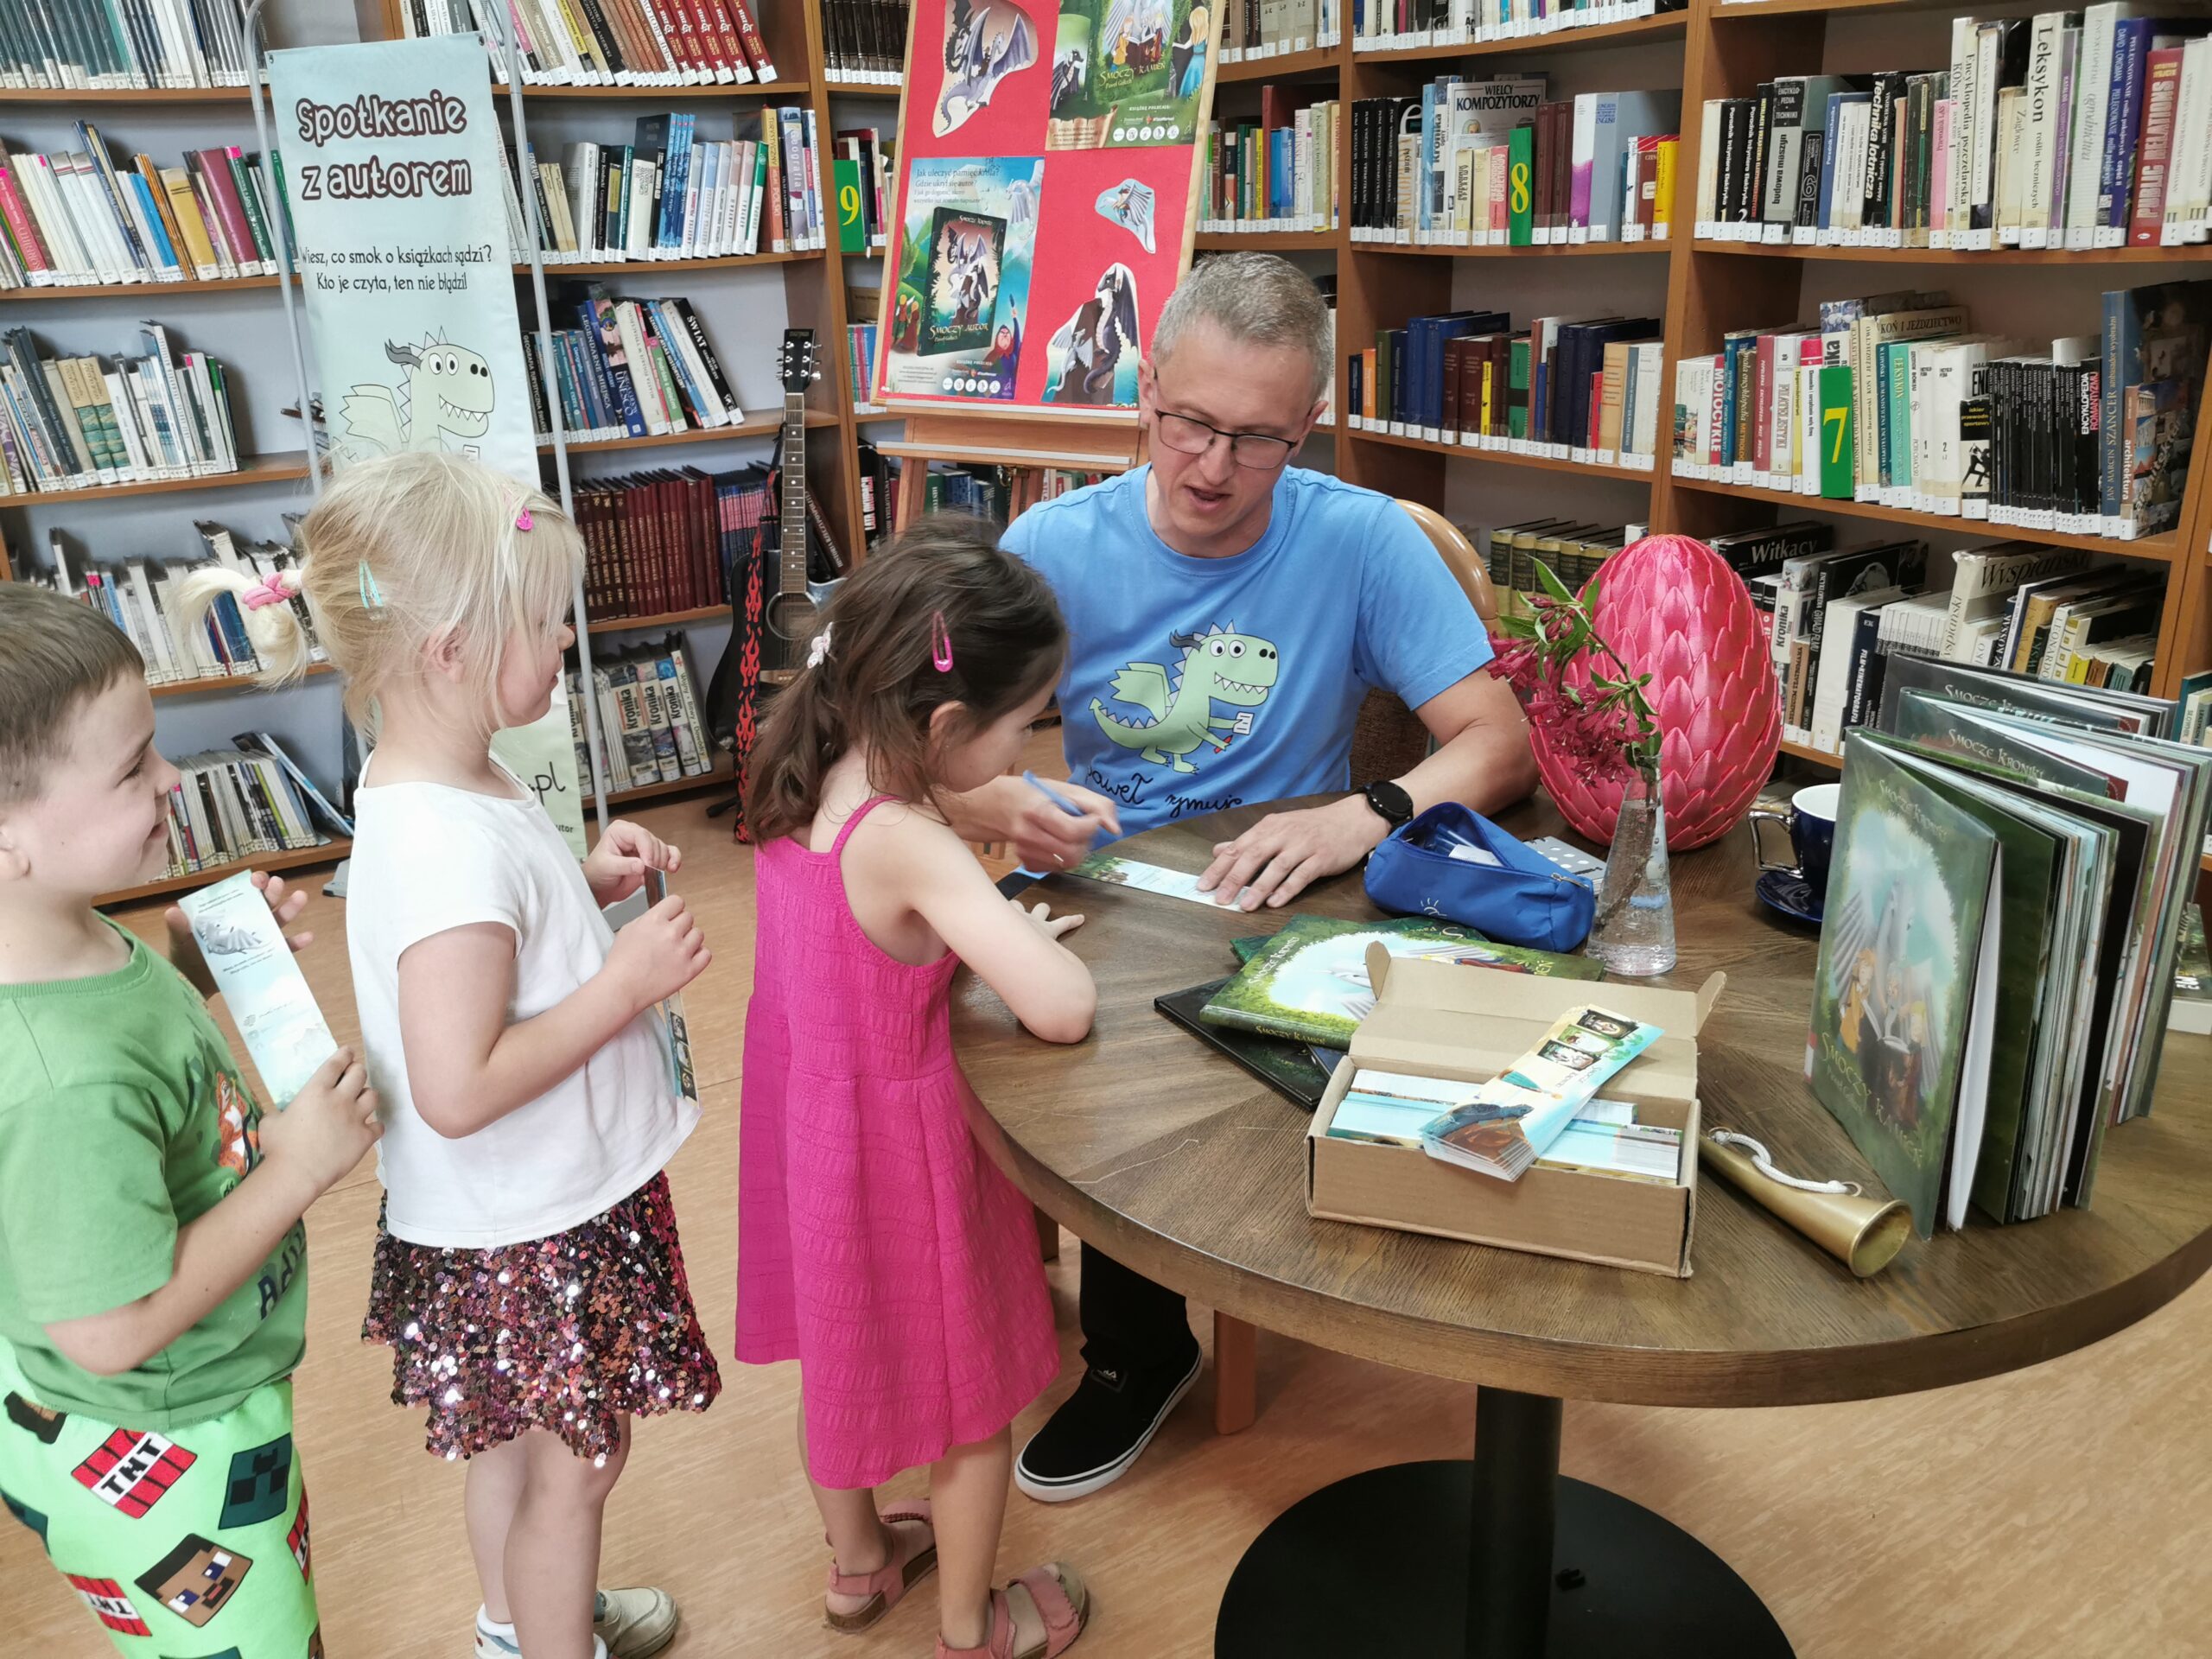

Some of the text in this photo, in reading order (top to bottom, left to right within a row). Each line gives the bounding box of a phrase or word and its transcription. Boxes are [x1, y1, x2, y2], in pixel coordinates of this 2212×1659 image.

[2117, 29, 2126, 51] DAVID
[1099, 68, 1135, 86] SMOCZY
[1951, 63, 1962, 103] KONIE
[2113, 52, 2124, 81] LONGMAN
[2124, 36, 2137, 99] PIELĘGNOWANIE
[1456, 94, 1541, 111] KOMPOZYTORZY
[1484, 85, 1514, 95] WIELCY
[2082, 19, 2103, 162] ENCYKLOPEDIA ogrodnictwa
[296, 90, 467, 147] Spotkanie
[1960, 54, 1975, 205] Encyklopedia pszczelarska
[2031, 27, 2054, 209] Leksykon roślin leczniczych
[2107, 88, 2120, 137] PIELĘGNOWANIE
[2143, 80, 2175, 159] RELATIONS
[1722, 107, 1736, 205] Poradnik Inżyniera Elektryka
[1745, 134, 1753, 171] Inżyniera
[1866, 79, 1885, 199] Technika lotnicza
[2119, 119, 2127, 156] pokojowych
[302, 156, 472, 200] z autorem
[791, 131, 803, 188] Geografia
[916, 168, 926, 177] Jak
[1772, 134, 1787, 204] budowa maszyn
[1975, 154, 1984, 194] WIELKA
[840, 185, 860, 226] 9
[1511, 162, 1529, 213] 8
[1741, 173, 1750, 205] Elektryka
[2137, 165, 2164, 218] PUBLIC
[1738, 208, 1748, 222] 2
[2166, 213, 2177, 223] II
[331, 252, 346, 264] co
[349, 248, 383, 264] smok
[385, 253, 395, 264] o
[398, 245, 454, 267] książkach
[454, 244, 493, 267] sądzi?
[317, 274, 467, 294] Kto je czyta, ten nie błądzi!
[686, 315, 706, 347] ŚWIAT
[929, 323, 988, 340] SMOCZY AUTOR
[1881, 321, 1898, 334] KOŃ
[1906, 315, 1961, 331] JEŹDZIECTWO
[523, 334, 532, 369] GEOGRAFIA
[531, 370, 542, 410] TURYSTYCZNA
[582, 314, 611, 409] LEGENDARNE MIEJSCA
[1894, 357, 1904, 398] LEKSYKON
[615, 371, 634, 416] UNESCO
[1711, 368, 1724, 452] MOTOCYKLE
[1738, 373, 1749, 421] encyklopedia
[2089, 372, 2099, 430] ROMANTYZMU
[1776, 384, 1789, 449] FILATELISTYKI
[1823, 407, 1848, 463] 7
[2107, 391, 2116, 446] SZANCER
[2122, 439, 2132, 500] architektura
[864, 513, 876, 531] LATA
[1751, 539, 1818, 563] Witkacy
[1776, 605, 1789, 648] Kronika
[1810, 572, 1827, 653] ENCYKLOPEDIA GWIAZD FILMU
[1997, 614, 2012, 653] KOSSAK
[2042, 616, 2063, 679] LEONARDO
[675, 657, 683, 667] 4
[621, 689, 639, 729] Kronika
[645, 686, 662, 726] Kronika
[665, 685, 681, 719] Kronika
[1945, 683, 1998, 707] SMOCZE
[695, 726, 705, 756] Dowódcy
[1948, 728, 2046, 779] SMOCZE KRONIKI
[1249, 955, 1280, 985] SMOCZE
[1255, 1025, 1290, 1038] SMOCZY
[1821, 1031, 1873, 1111] SMOCZY
[101, 1434, 162, 1495] TNT
